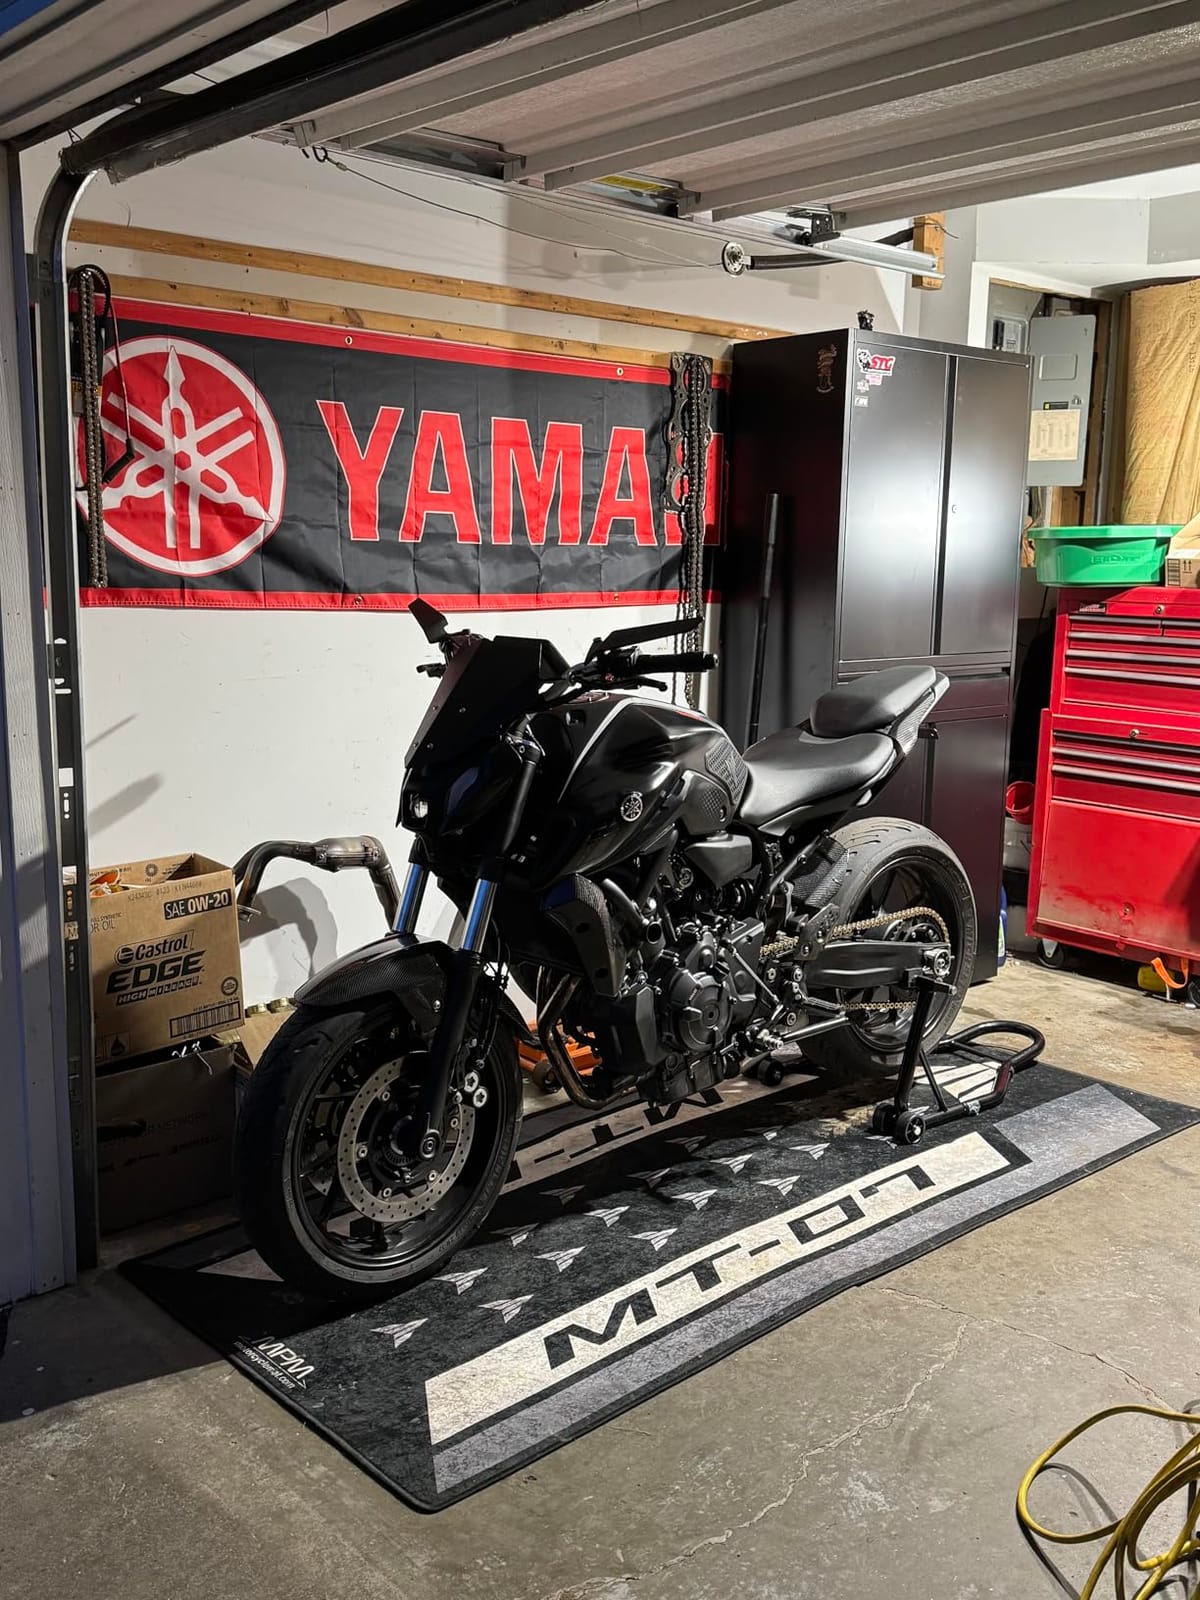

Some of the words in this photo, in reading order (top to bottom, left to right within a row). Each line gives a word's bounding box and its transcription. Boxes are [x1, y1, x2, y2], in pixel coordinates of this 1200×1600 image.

[165, 902, 186, 917] SAE
[187, 891, 229, 915] 0W-20
[102, 919, 116, 931] OIL
[136, 934, 188, 961] Castrol
[106, 951, 206, 995] EDGE
[118, 991, 147, 1004] HIGH
[545, 1163, 935, 1370] MT-07
